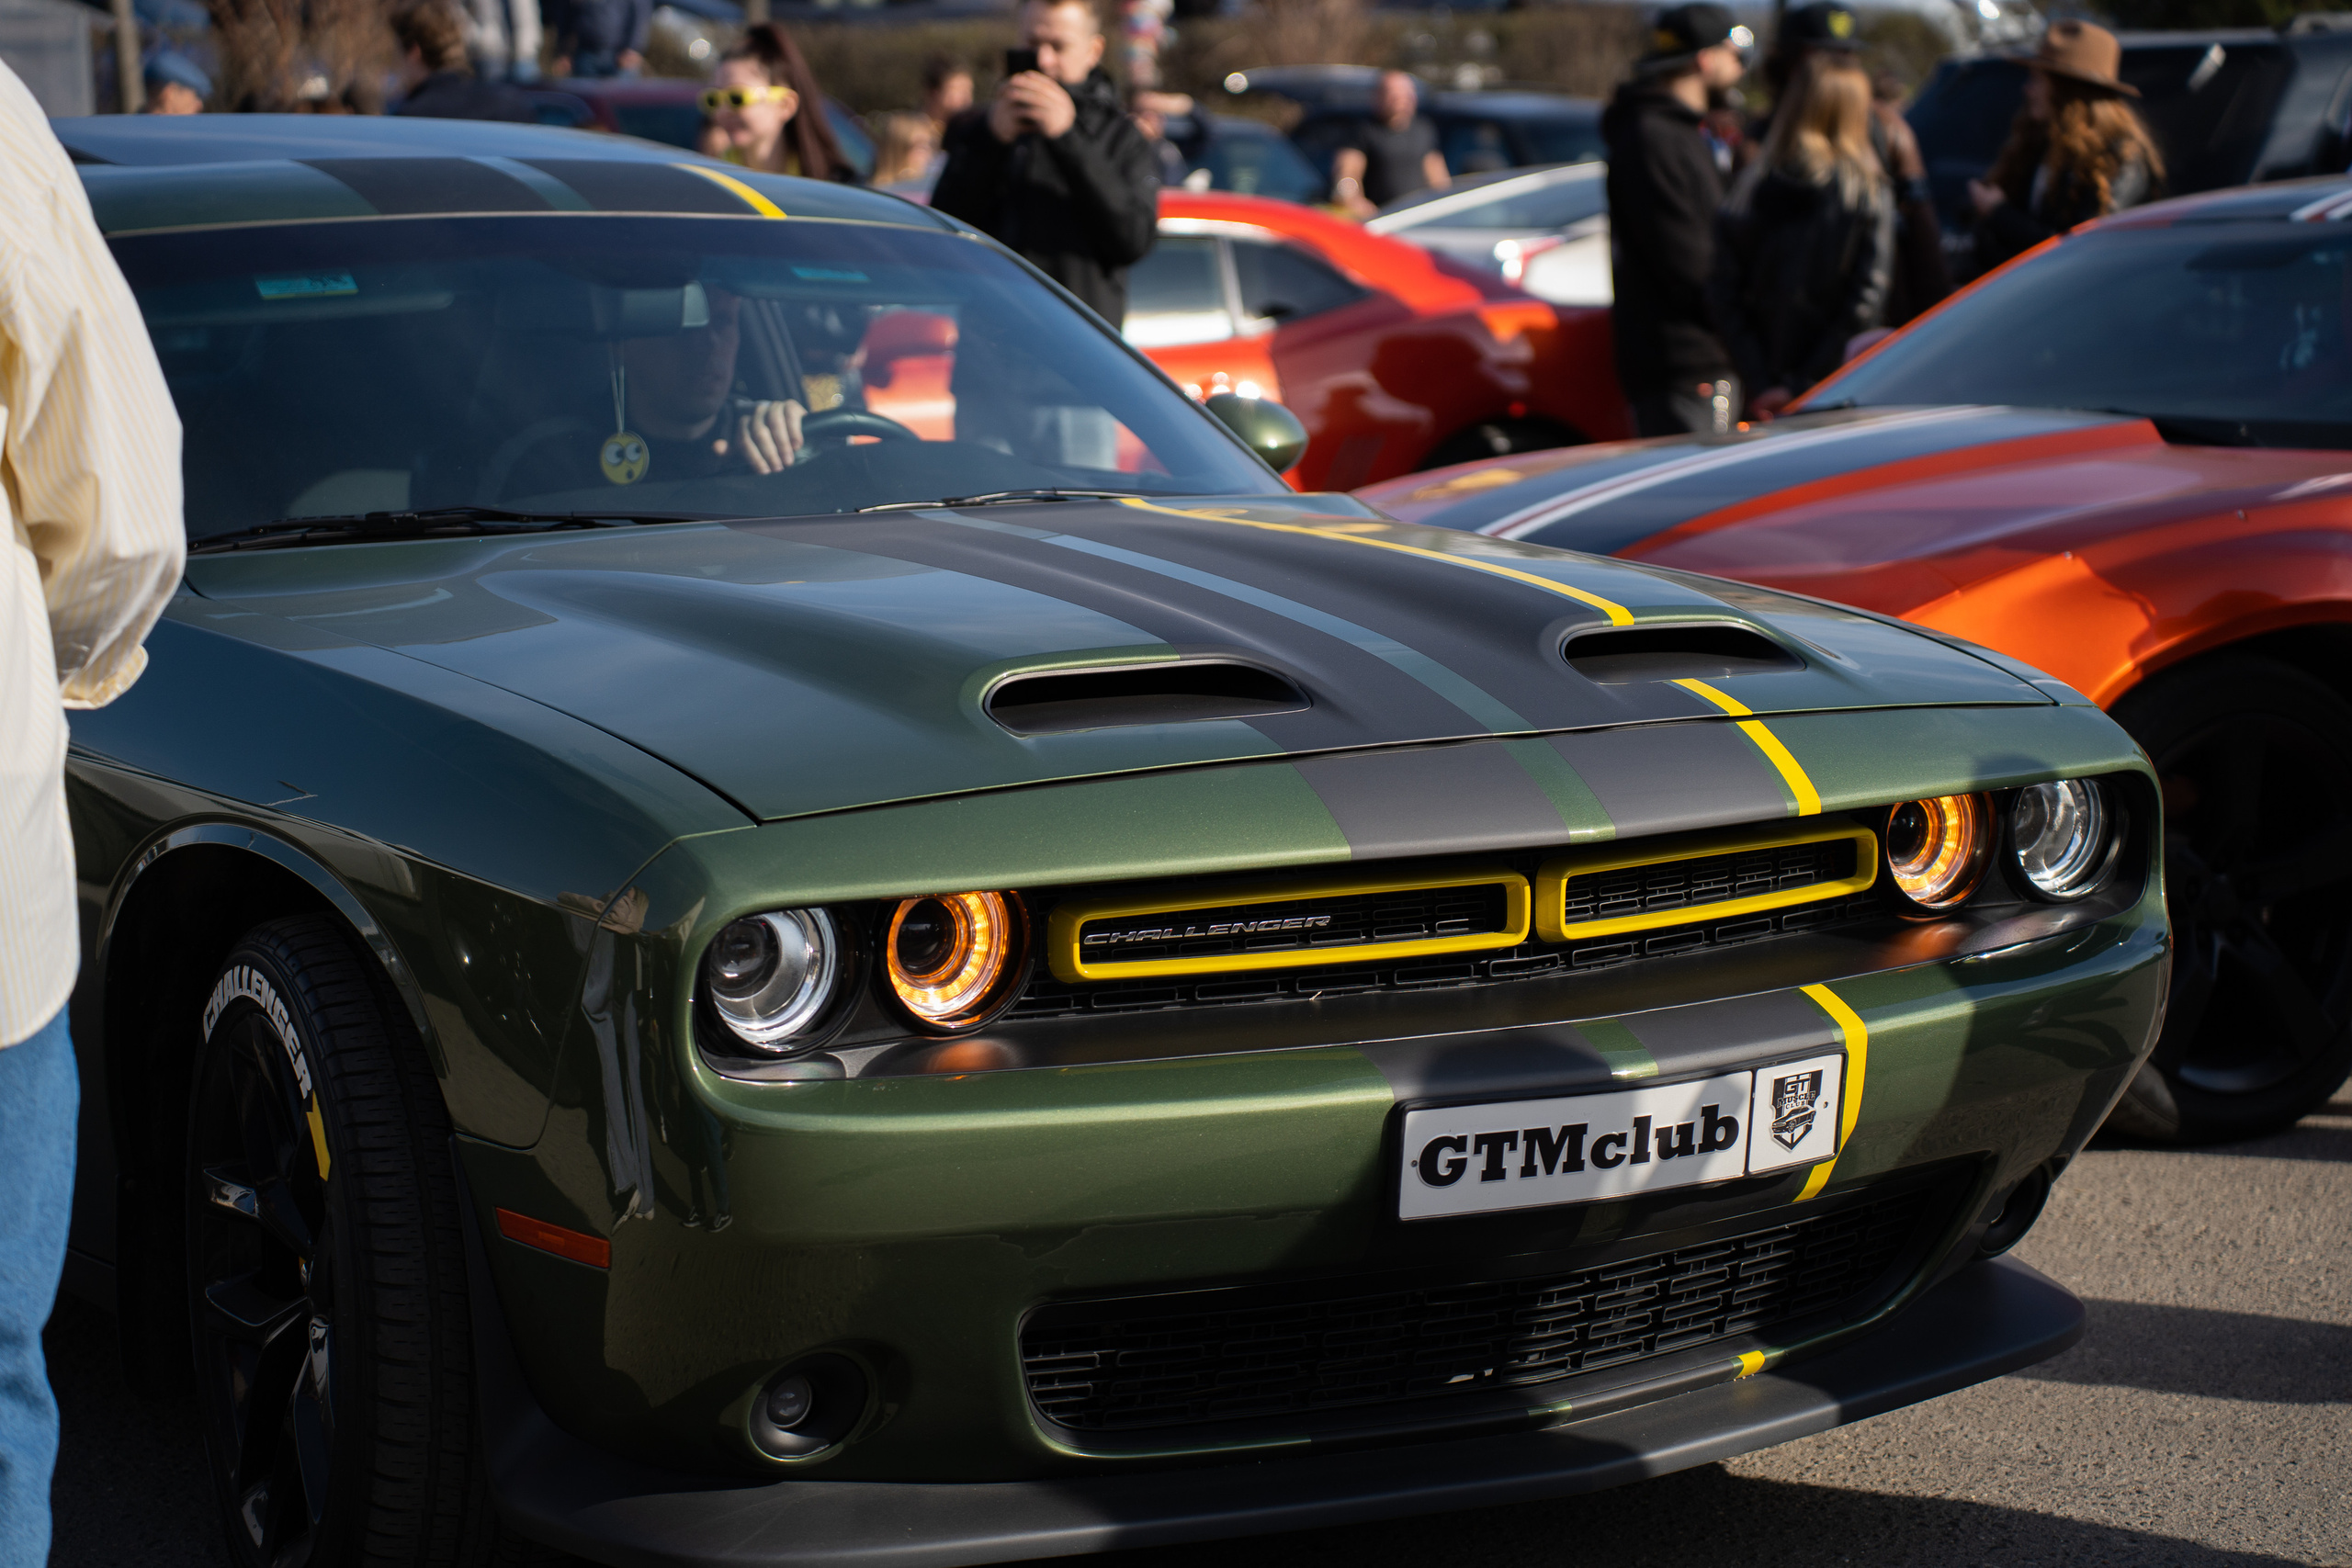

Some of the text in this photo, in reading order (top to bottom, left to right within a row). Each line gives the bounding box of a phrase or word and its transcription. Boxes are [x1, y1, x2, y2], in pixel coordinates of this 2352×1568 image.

[1084, 915, 1331, 945] CHALLENGER
[203, 964, 312, 1100] CHALLENGER
[1785, 1077, 1810, 1095] GT
[1777, 1090, 1815, 1109] MUSCLE
[1785, 1100, 1805, 1110] CLUB
[1419, 1104, 1740, 1187] GTMclub
